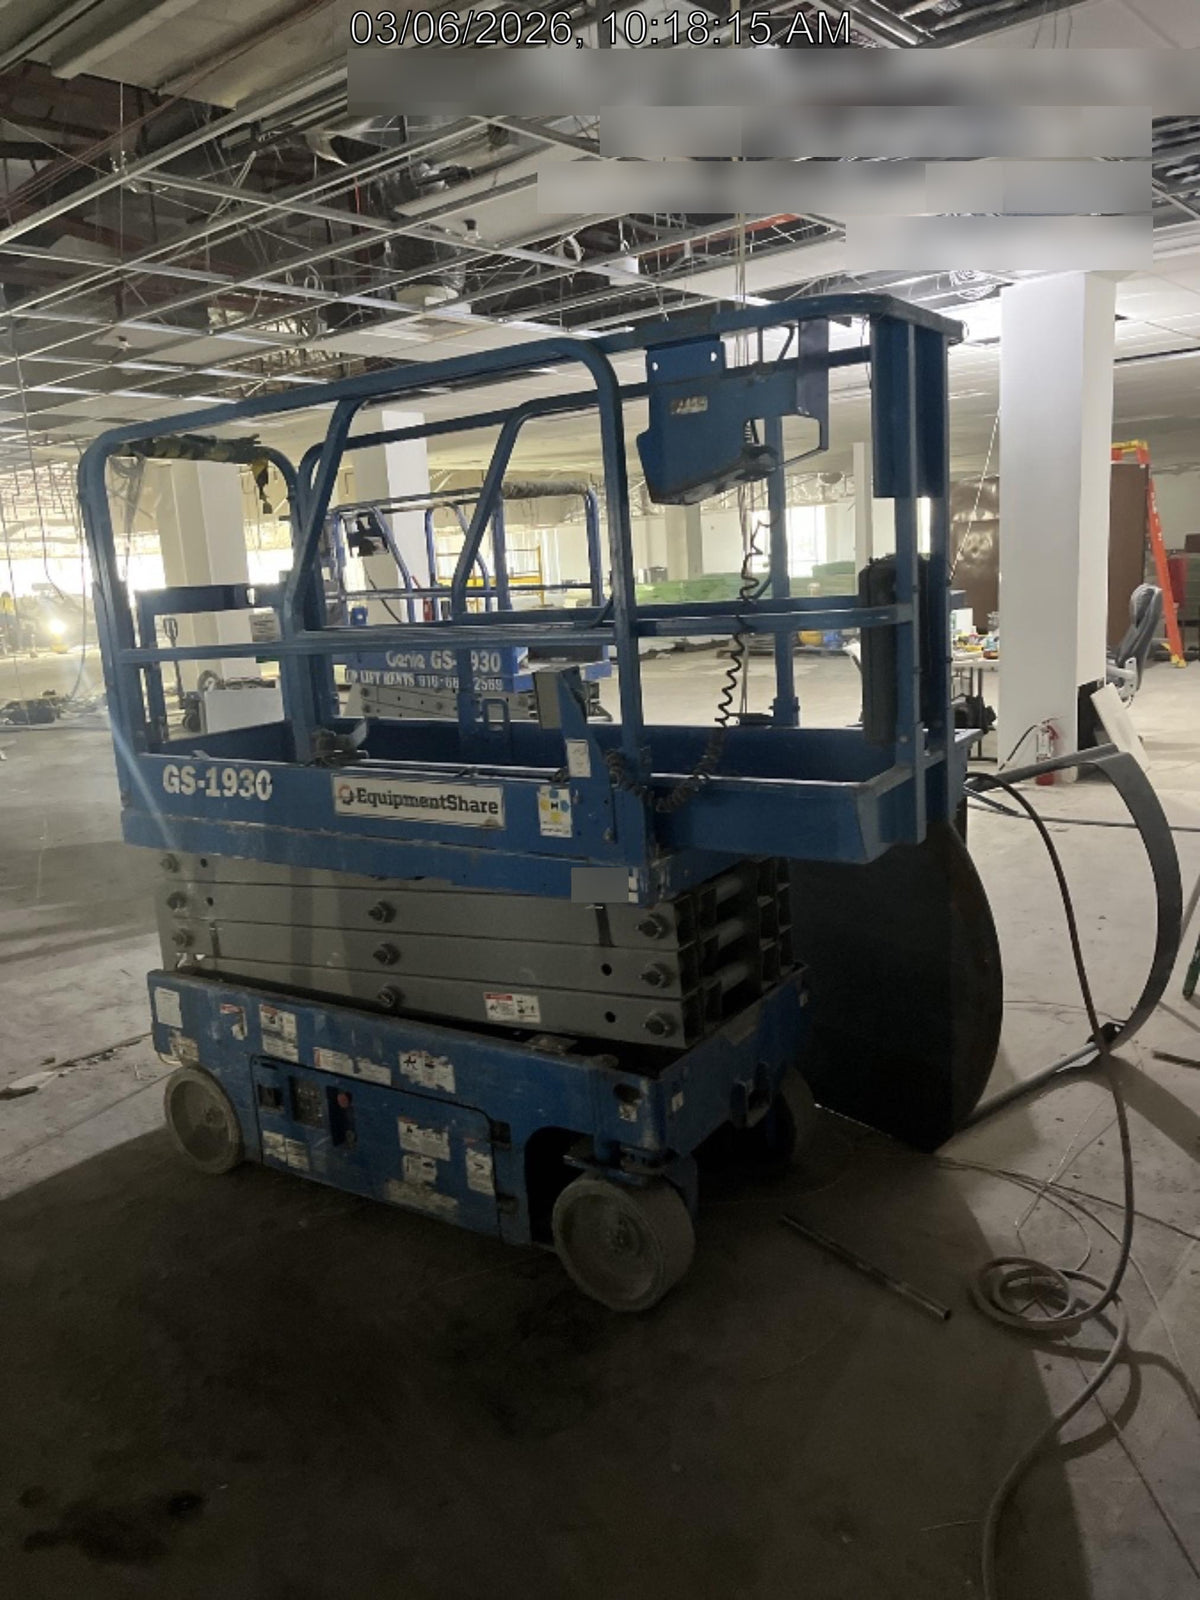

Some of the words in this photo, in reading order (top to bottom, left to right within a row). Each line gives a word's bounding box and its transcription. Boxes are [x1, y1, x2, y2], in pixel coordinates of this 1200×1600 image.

[430, 650, 501, 673] GS-930
[163, 764, 273, 801] GS-1930
[356, 787, 499, 814] EquipmentShare
